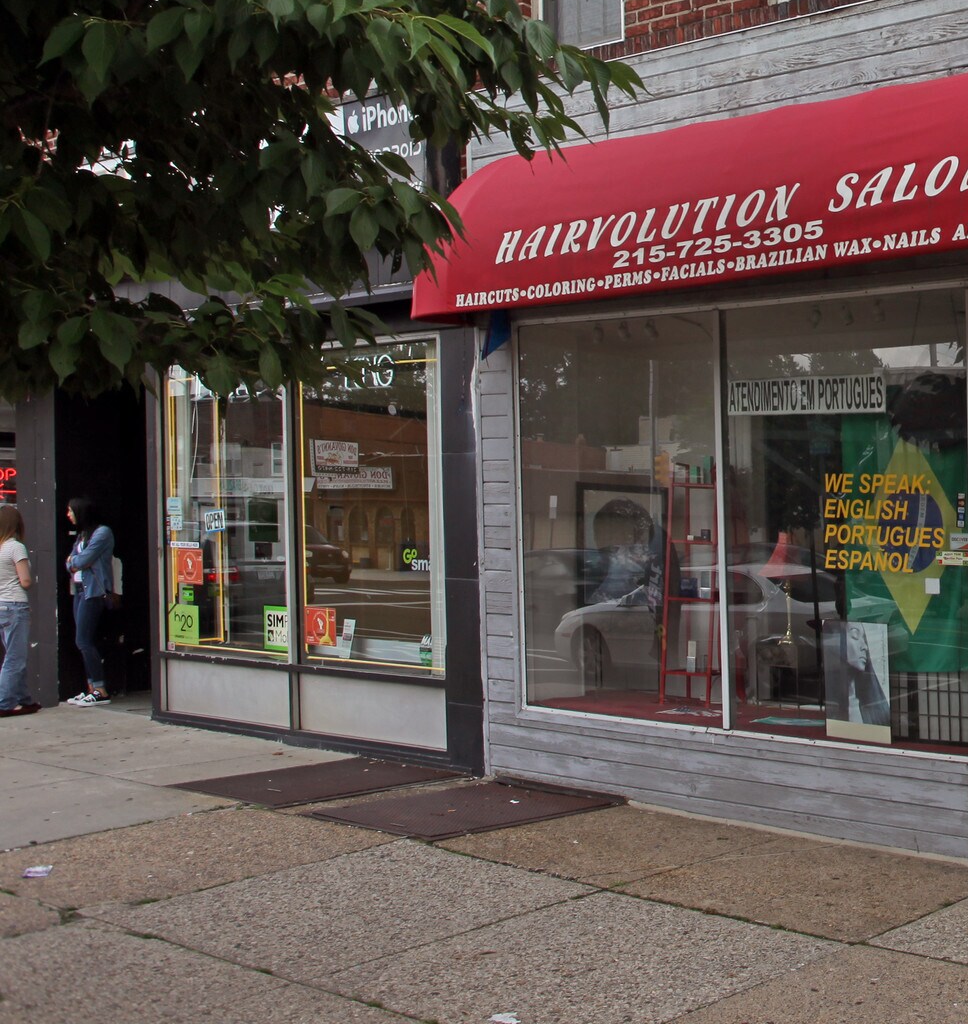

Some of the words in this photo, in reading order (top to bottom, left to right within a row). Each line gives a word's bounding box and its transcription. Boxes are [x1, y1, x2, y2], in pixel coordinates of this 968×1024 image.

[362, 103, 418, 132] iPhon
[495, 182, 800, 264] HAIRVOLUTION
[612, 219, 824, 268] 215-725-3305
[455, 289, 520, 307] HAIRCUTS
[527, 277, 596, 299] COLORING
[604, 269, 652, 289] PERMS
[661, 259, 725, 282] FACIALS
[735, 243, 827, 272] BRAZILIAN
[834, 237, 872, 258] WAX
[882, 227, 941, 250] NAILS
[729, 380, 797, 412] ATENDIMENTO
[801, 378, 815, 410] EM
[818, 376, 883, 410] PORTUGUES
[825, 473, 854, 493] WE
[859, 473, 931, 494] SPEAK:
[205, 511, 224, 529] OPEN
[824, 498, 909, 521] ENGLISH
[824, 524, 945, 548] PORTUGUES
[824, 548, 914, 573] ESPAÑOL
